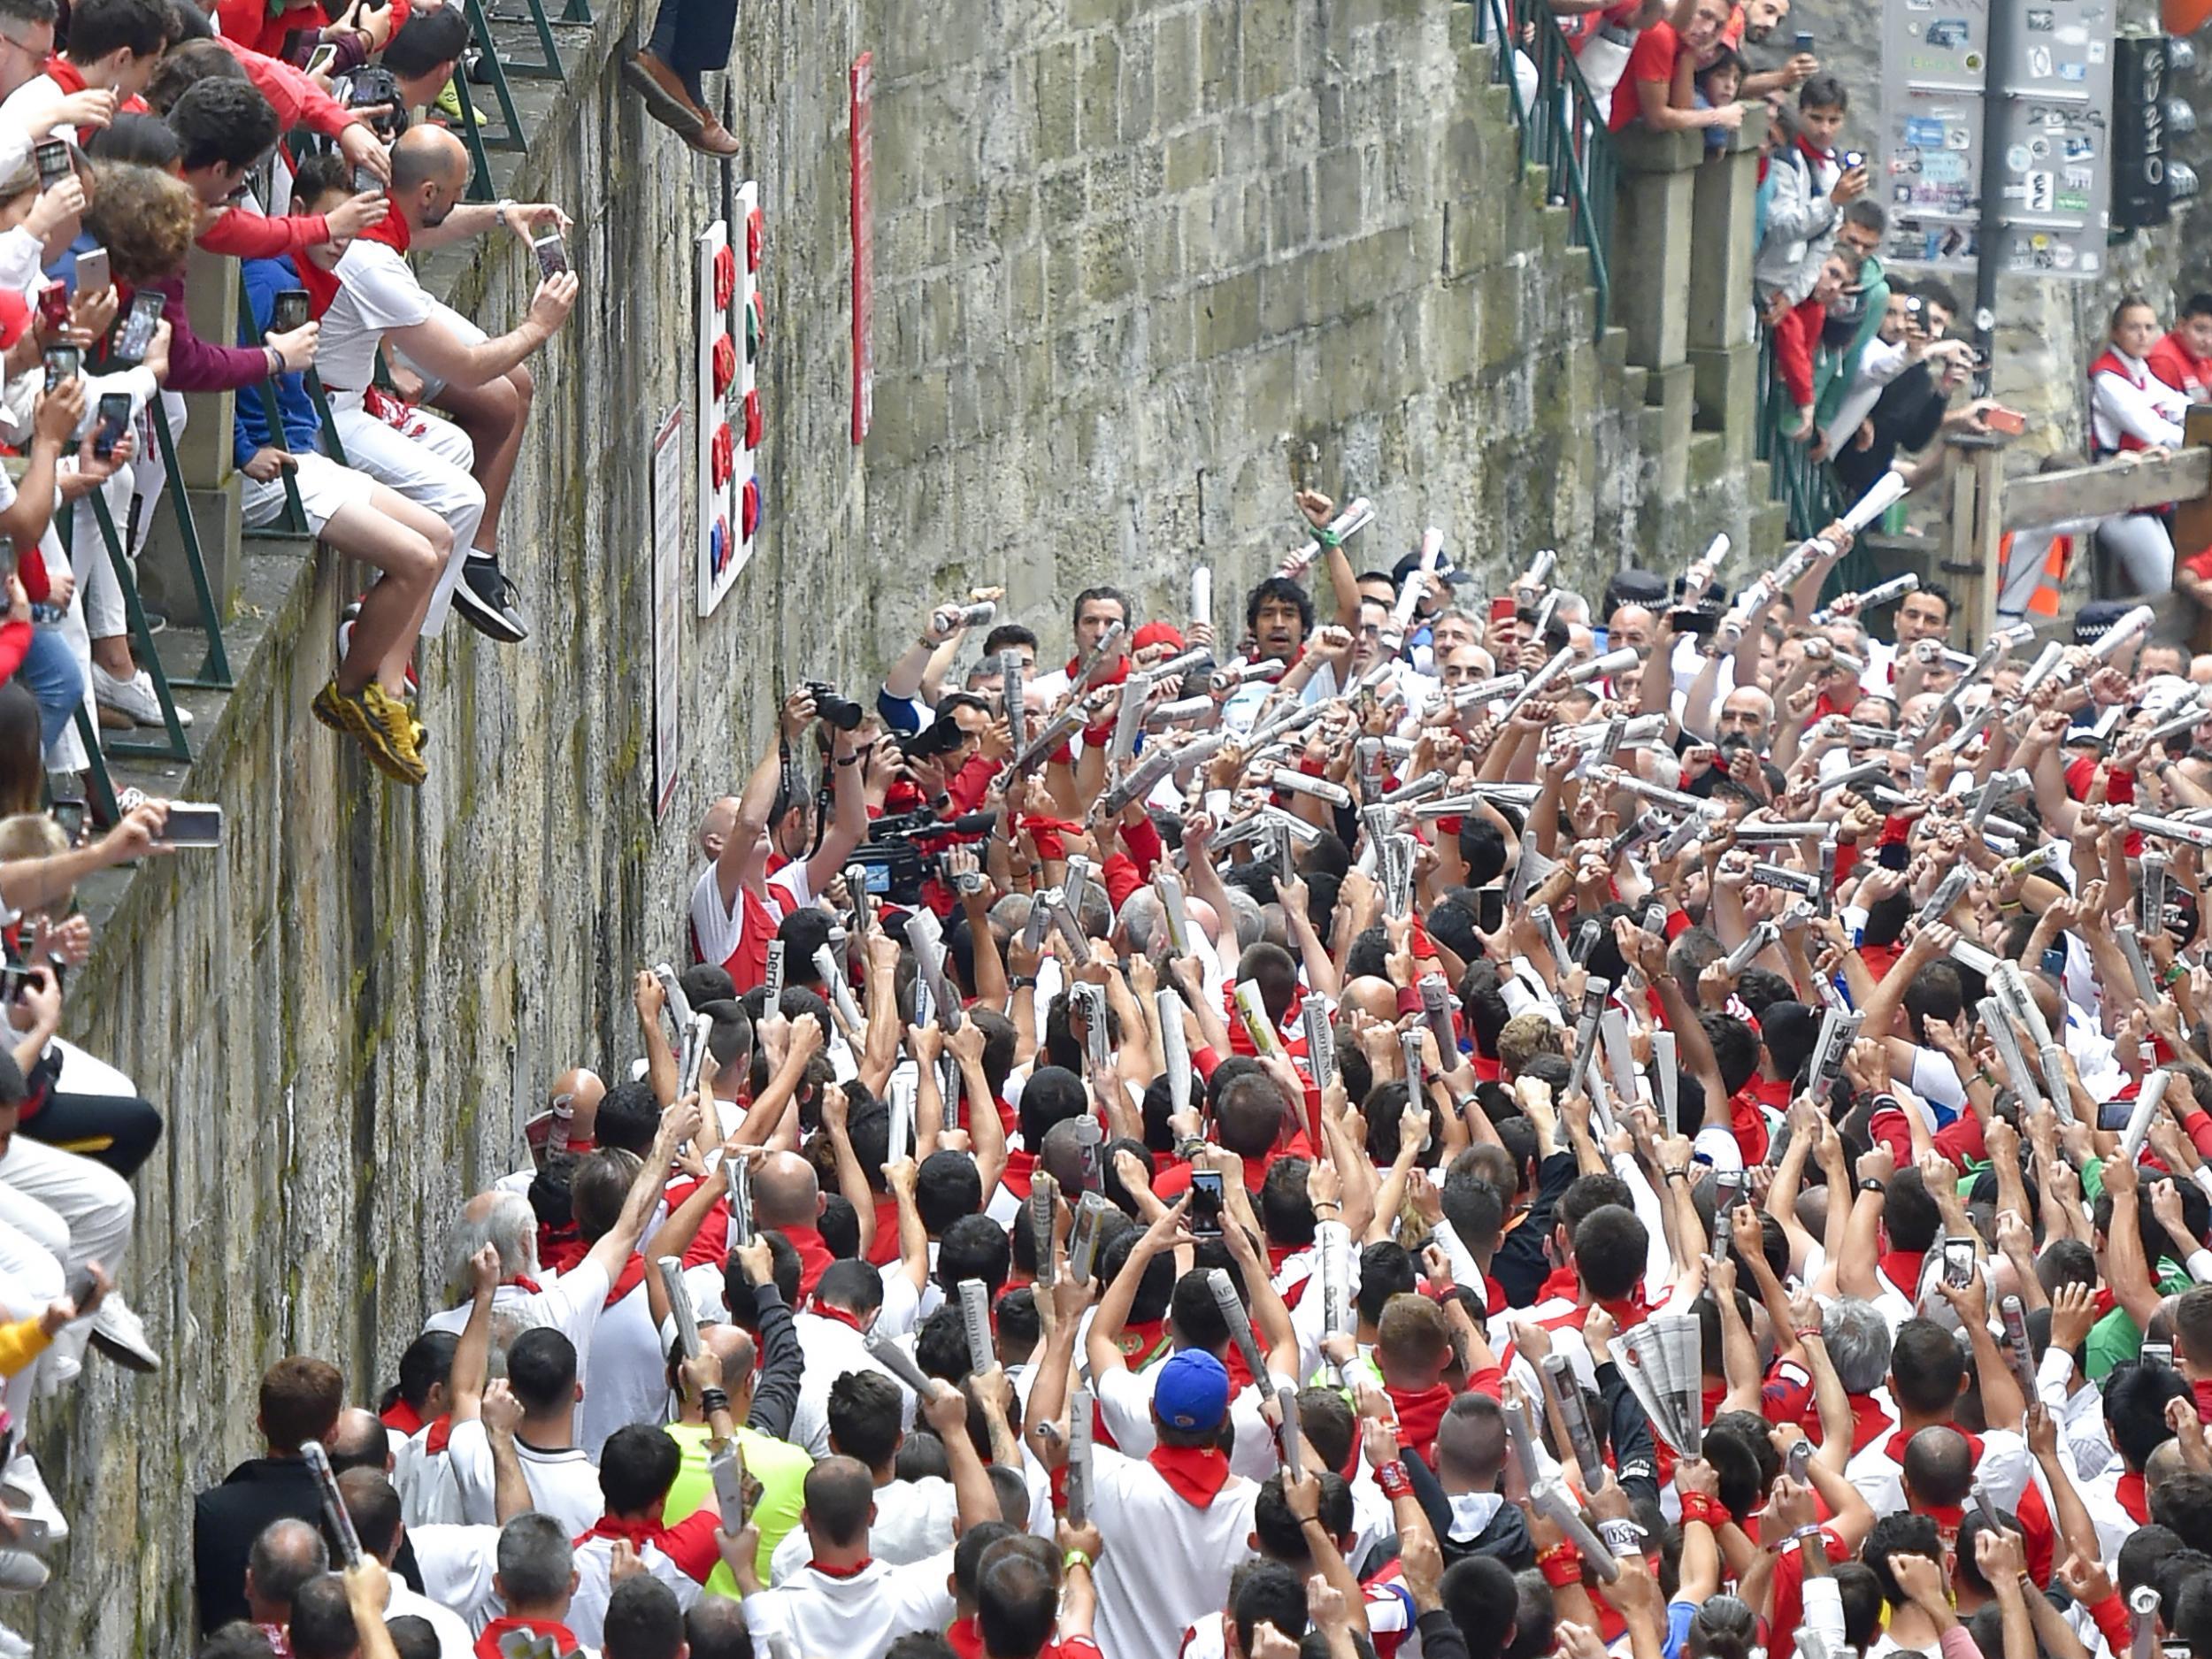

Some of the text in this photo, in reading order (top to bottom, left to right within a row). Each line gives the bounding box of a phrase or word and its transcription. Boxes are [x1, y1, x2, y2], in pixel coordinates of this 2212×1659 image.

[764, 950, 781, 999] berria
[964, 1292, 978, 1331] DIARIO
[970, 1333, 981, 1346] DE
